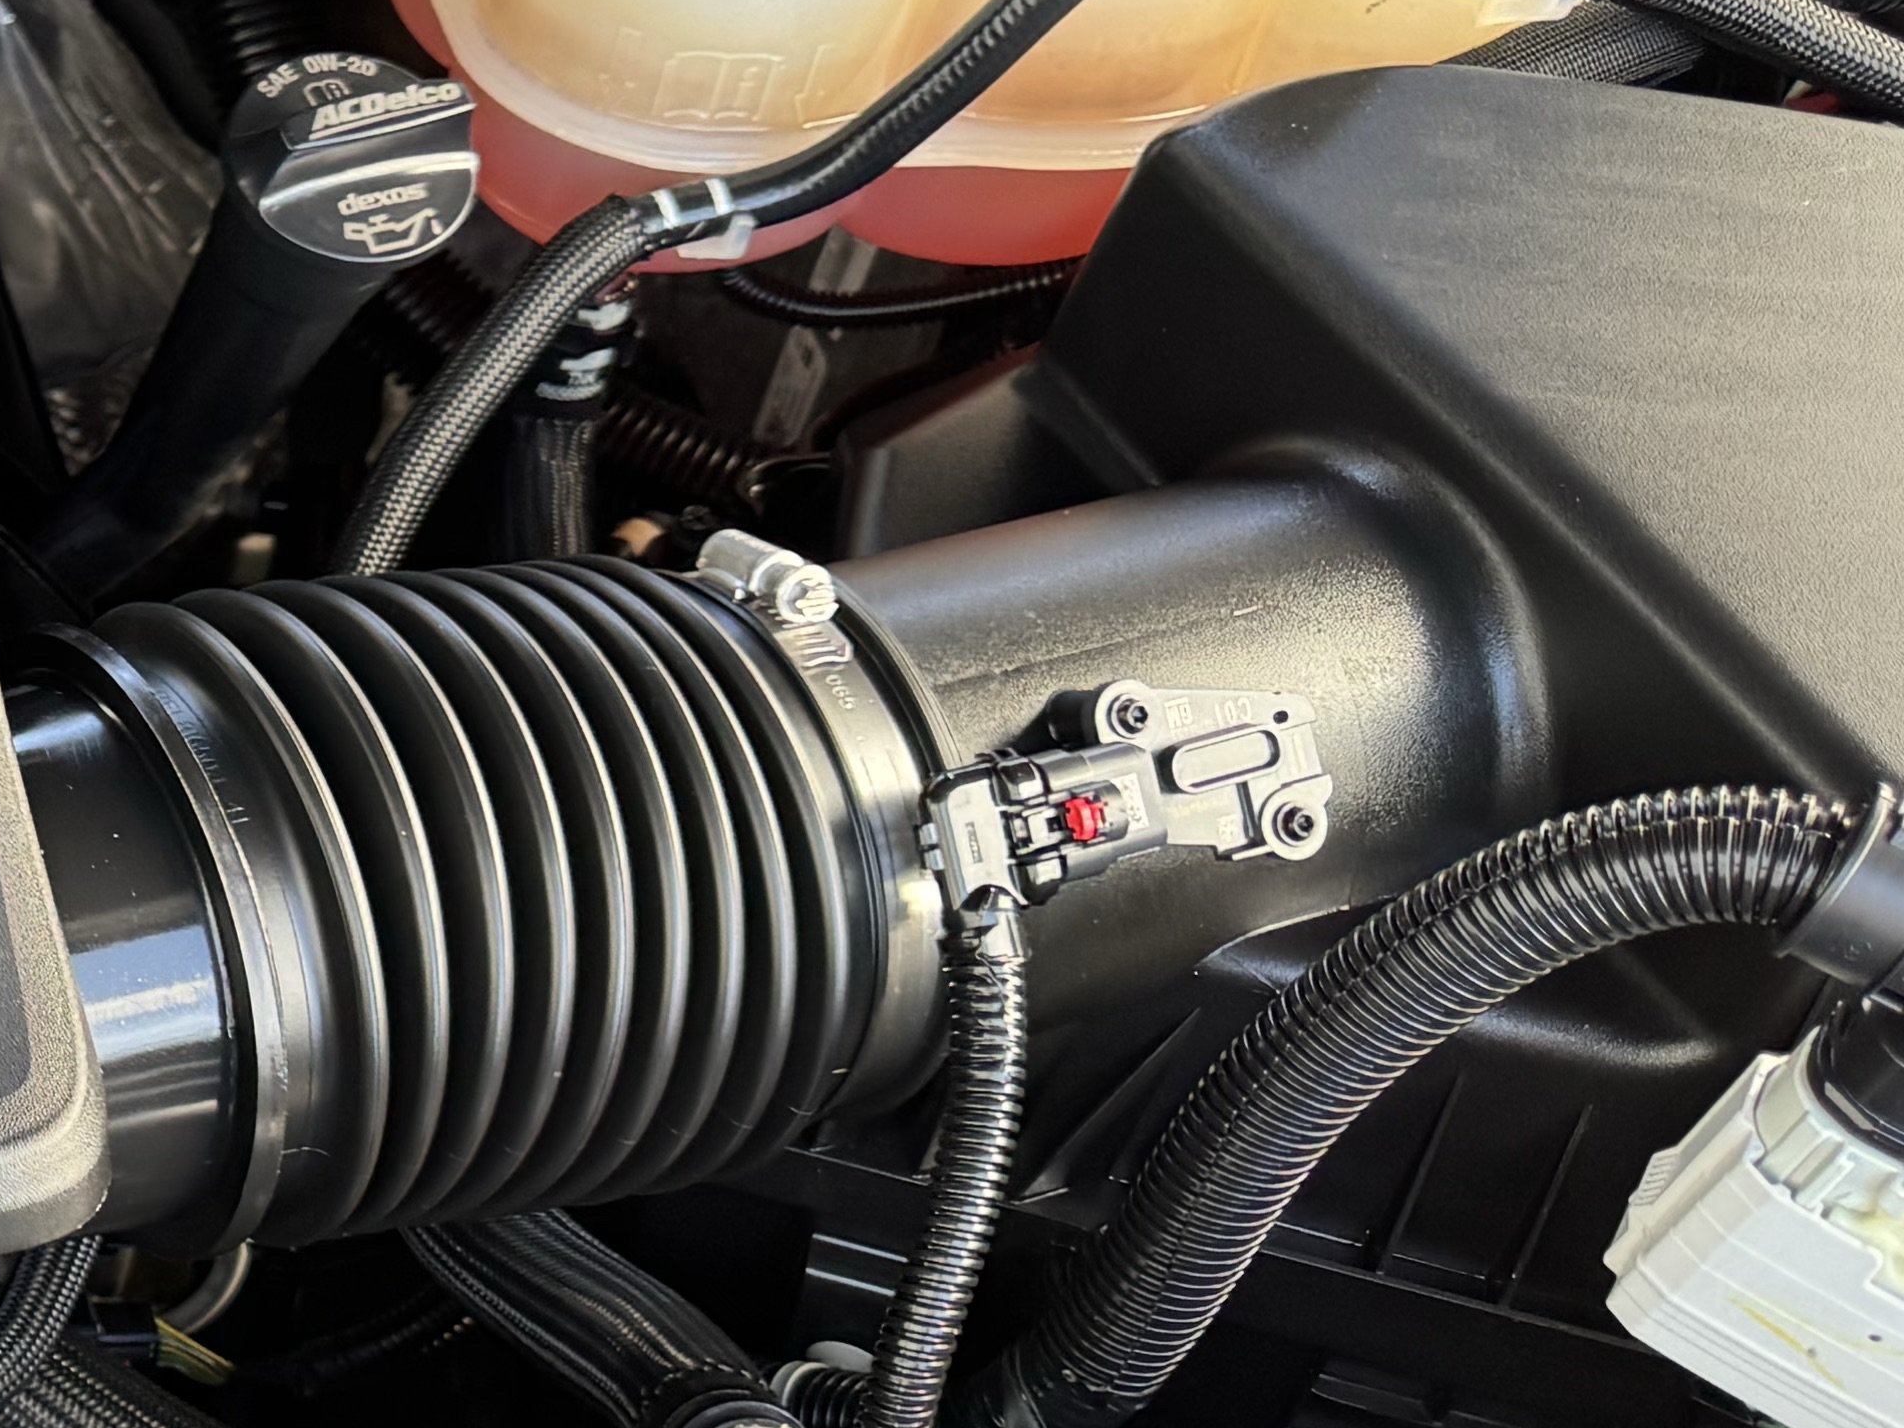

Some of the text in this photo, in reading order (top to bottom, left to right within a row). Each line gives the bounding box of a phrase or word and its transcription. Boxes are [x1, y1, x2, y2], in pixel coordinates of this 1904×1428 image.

[257, 63, 300, 99] SAE
[311, 82, 462, 132] ACDelco
[337, 182, 430, 216] dexos
[1164, 697, 1193, 729] GM
